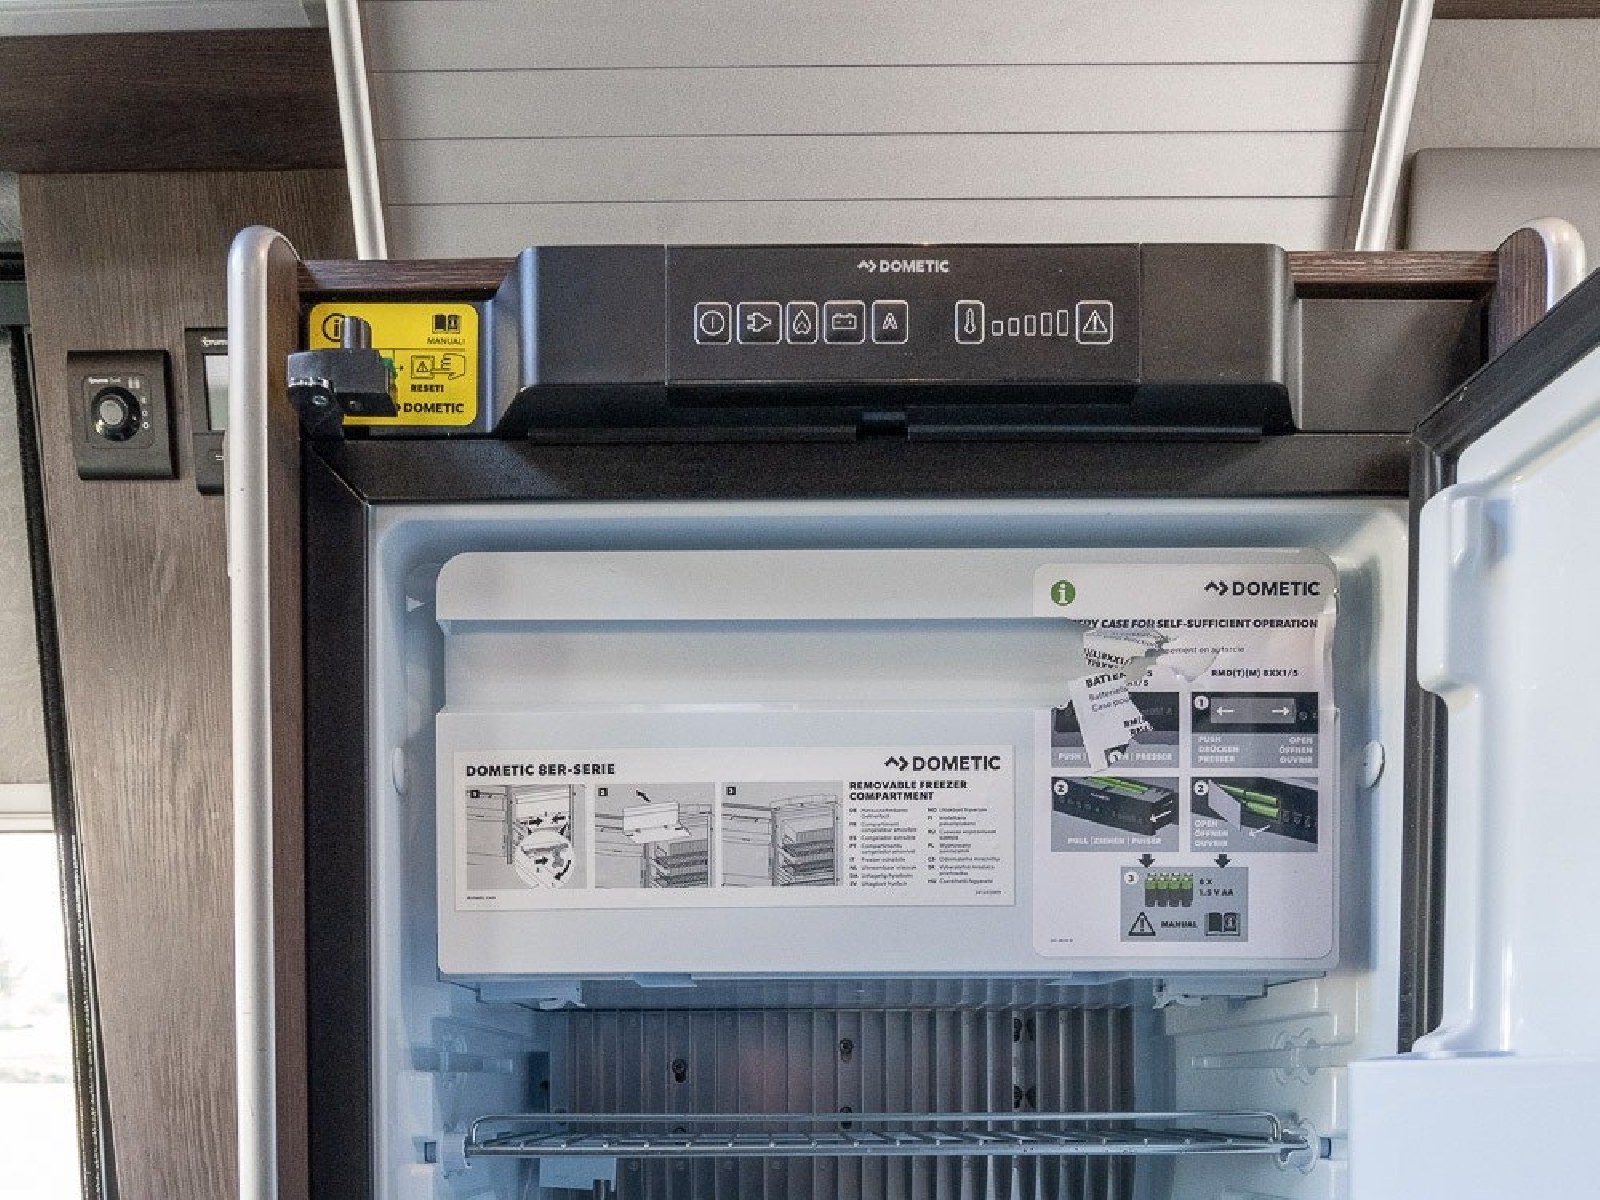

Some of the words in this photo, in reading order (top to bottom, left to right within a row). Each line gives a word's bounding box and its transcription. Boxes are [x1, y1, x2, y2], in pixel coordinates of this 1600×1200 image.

[879, 259, 950, 273] DOMETIC
[403, 402, 465, 414] DOMETIC
[1232, 581, 1321, 597] DOMETIC
[1101, 619, 1130, 629] CASE
[1131, 619, 1155, 629] FOR
[1156, 619, 1251, 629] SELF-SUFFICIENT
[1252, 619, 1319, 629] OPERATION
[912, 755, 1001, 772] DOMETIC
[466, 764, 536, 777] DOMETIC
[849, 781, 917, 790] REMOVABLE
[919, 780, 968, 789] FREEZER
[849, 791, 935, 801] COMPARTMENT
